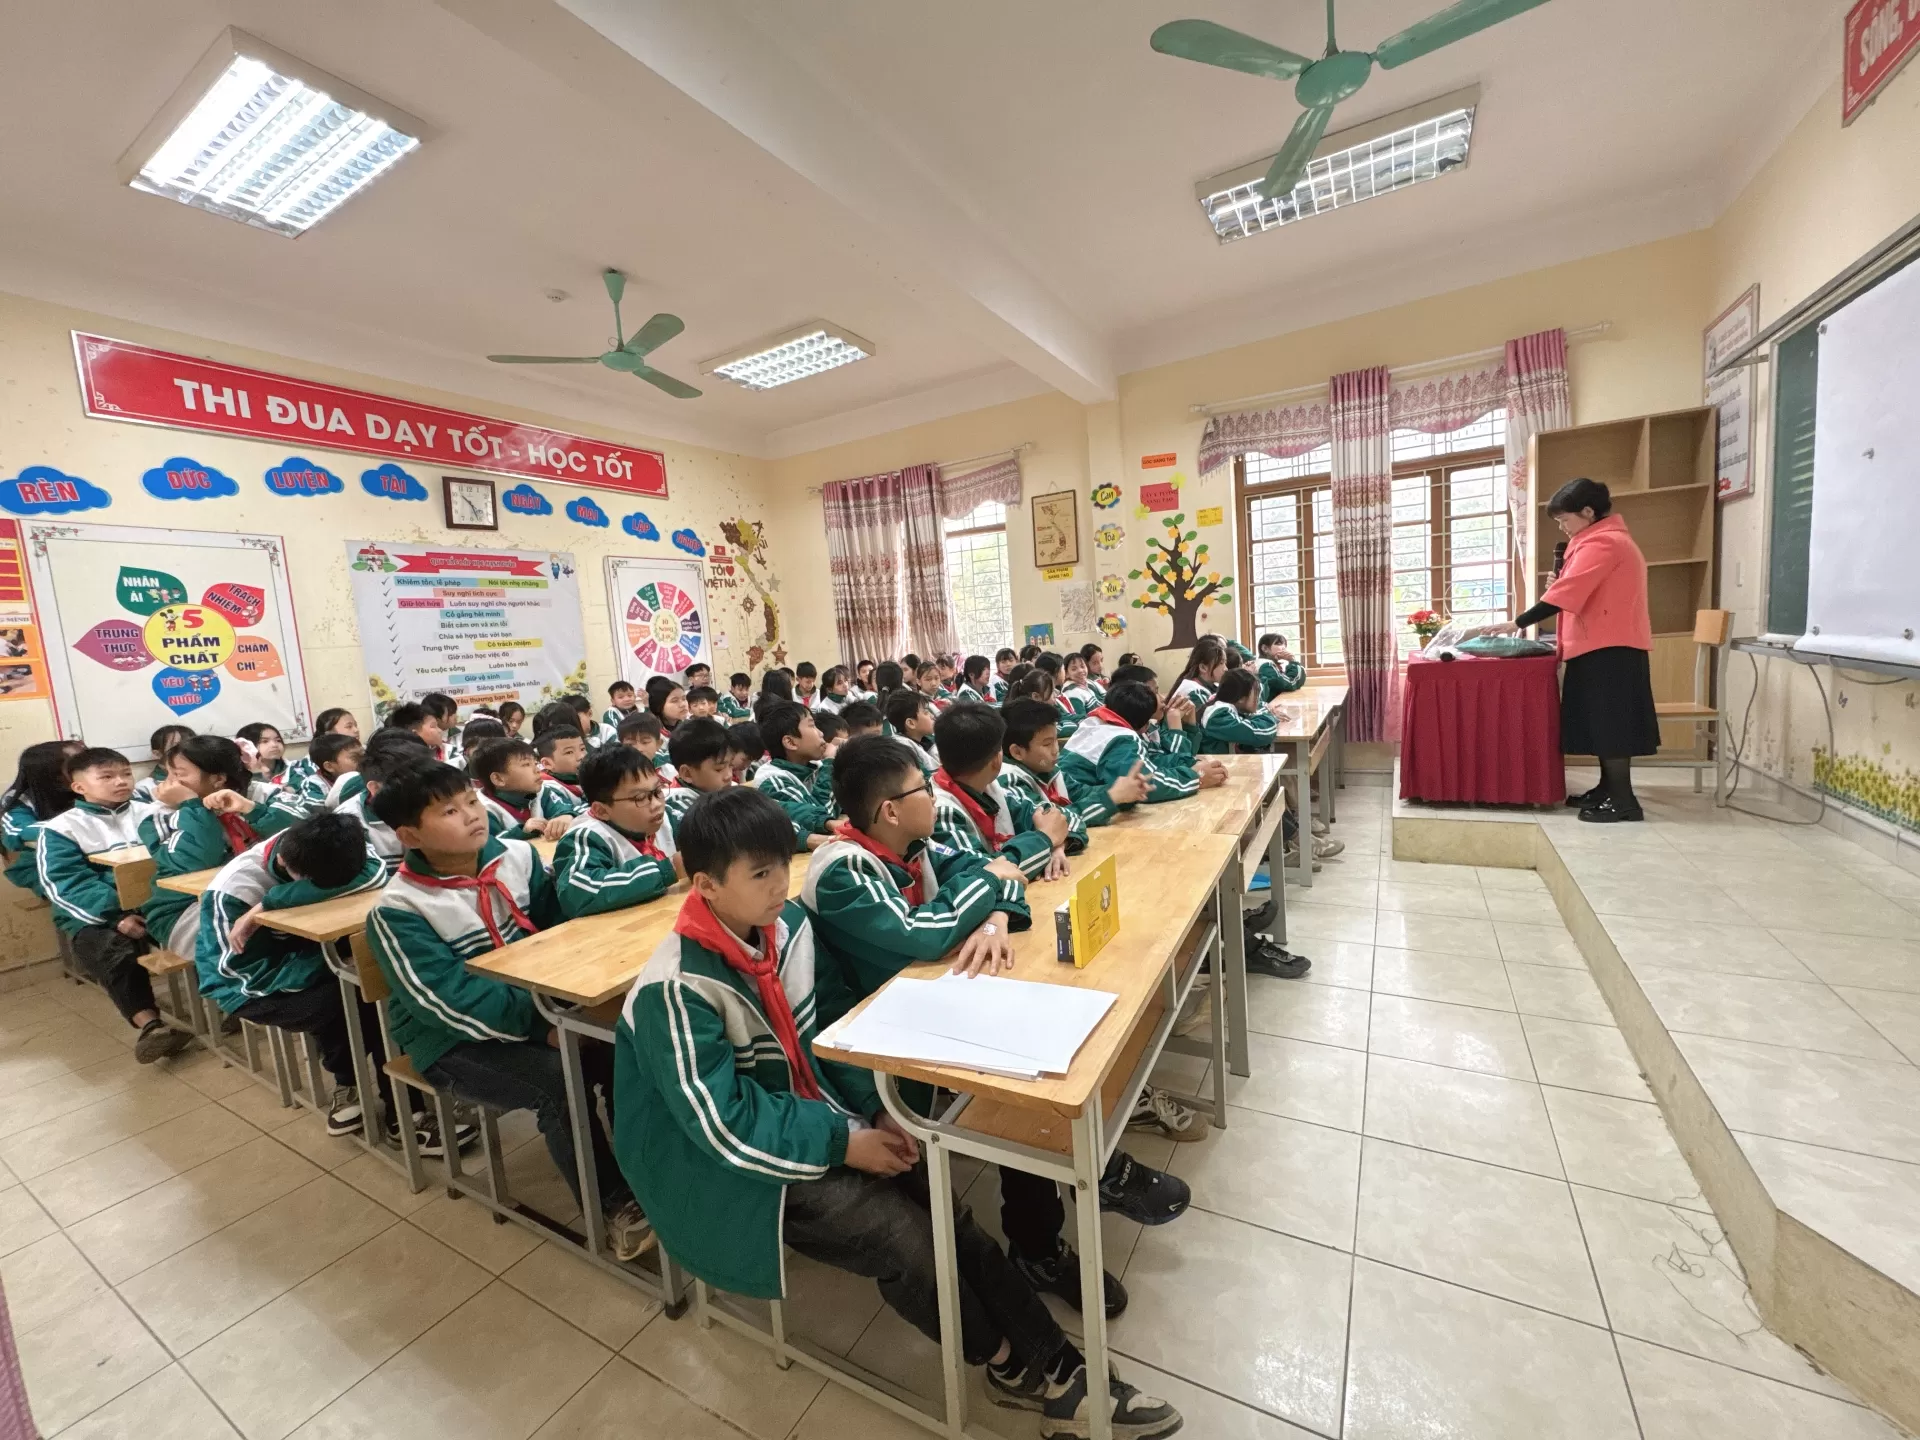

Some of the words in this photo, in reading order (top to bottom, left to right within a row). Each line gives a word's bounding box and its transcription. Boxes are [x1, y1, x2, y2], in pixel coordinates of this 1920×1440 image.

[174, 378, 251, 418] THI
[266, 396, 355, 436] ĐUA
[365, 413, 437, 451] DẠY
[447, 425, 502, 459] TỐT
[528, 444, 586, 474] HỌC
[593, 452, 633, 480] TỐT
[16, 478, 80, 504] RÈN
[166, 466, 212, 490] ĐỨC
[272, 467, 329, 492] LUYỆN
[380, 475, 407, 494] TÀI
[511, 494, 542, 510] NGÀY
[576, 504, 599, 521] MAI
[631, 519, 651, 533] LẬP
[710, 564, 726, 576] TÔI
[123, 576, 159, 588] NHÂN
[397, 578, 420, 586] Khiêm
[444, 578, 462, 587] phép
[522, 580, 539, 588] nhàng
[704, 577, 724, 590] VIỆT
[130, 591, 144, 603] ÁI
[442, 590, 456, 598] Suy
[207, 592, 242, 615] NHIỆM
[481, 600, 494, 608] nghĩ
[182, 610, 205, 629] 5
[456, 611, 473, 619] gắng
[95, 628, 139, 639] TRUNG
[162, 632, 220, 649] PHẨM
[103, 643, 137, 654] THỰC
[169, 650, 220, 665] CHẤT
[475, 652, 486, 660] học
[431, 666, 447, 674] cuộc
[448, 665, 466, 673] sống
[161, 675, 185, 688] YÊU
[448, 688, 464, 696] ngày
[477, 684, 494, 692] Siêng
[168, 692, 202, 706] NƯỚC
[456, 697, 469, 705] Yêu
[470, 696, 493, 704] thương
[494, 694, 506, 702] bạn
